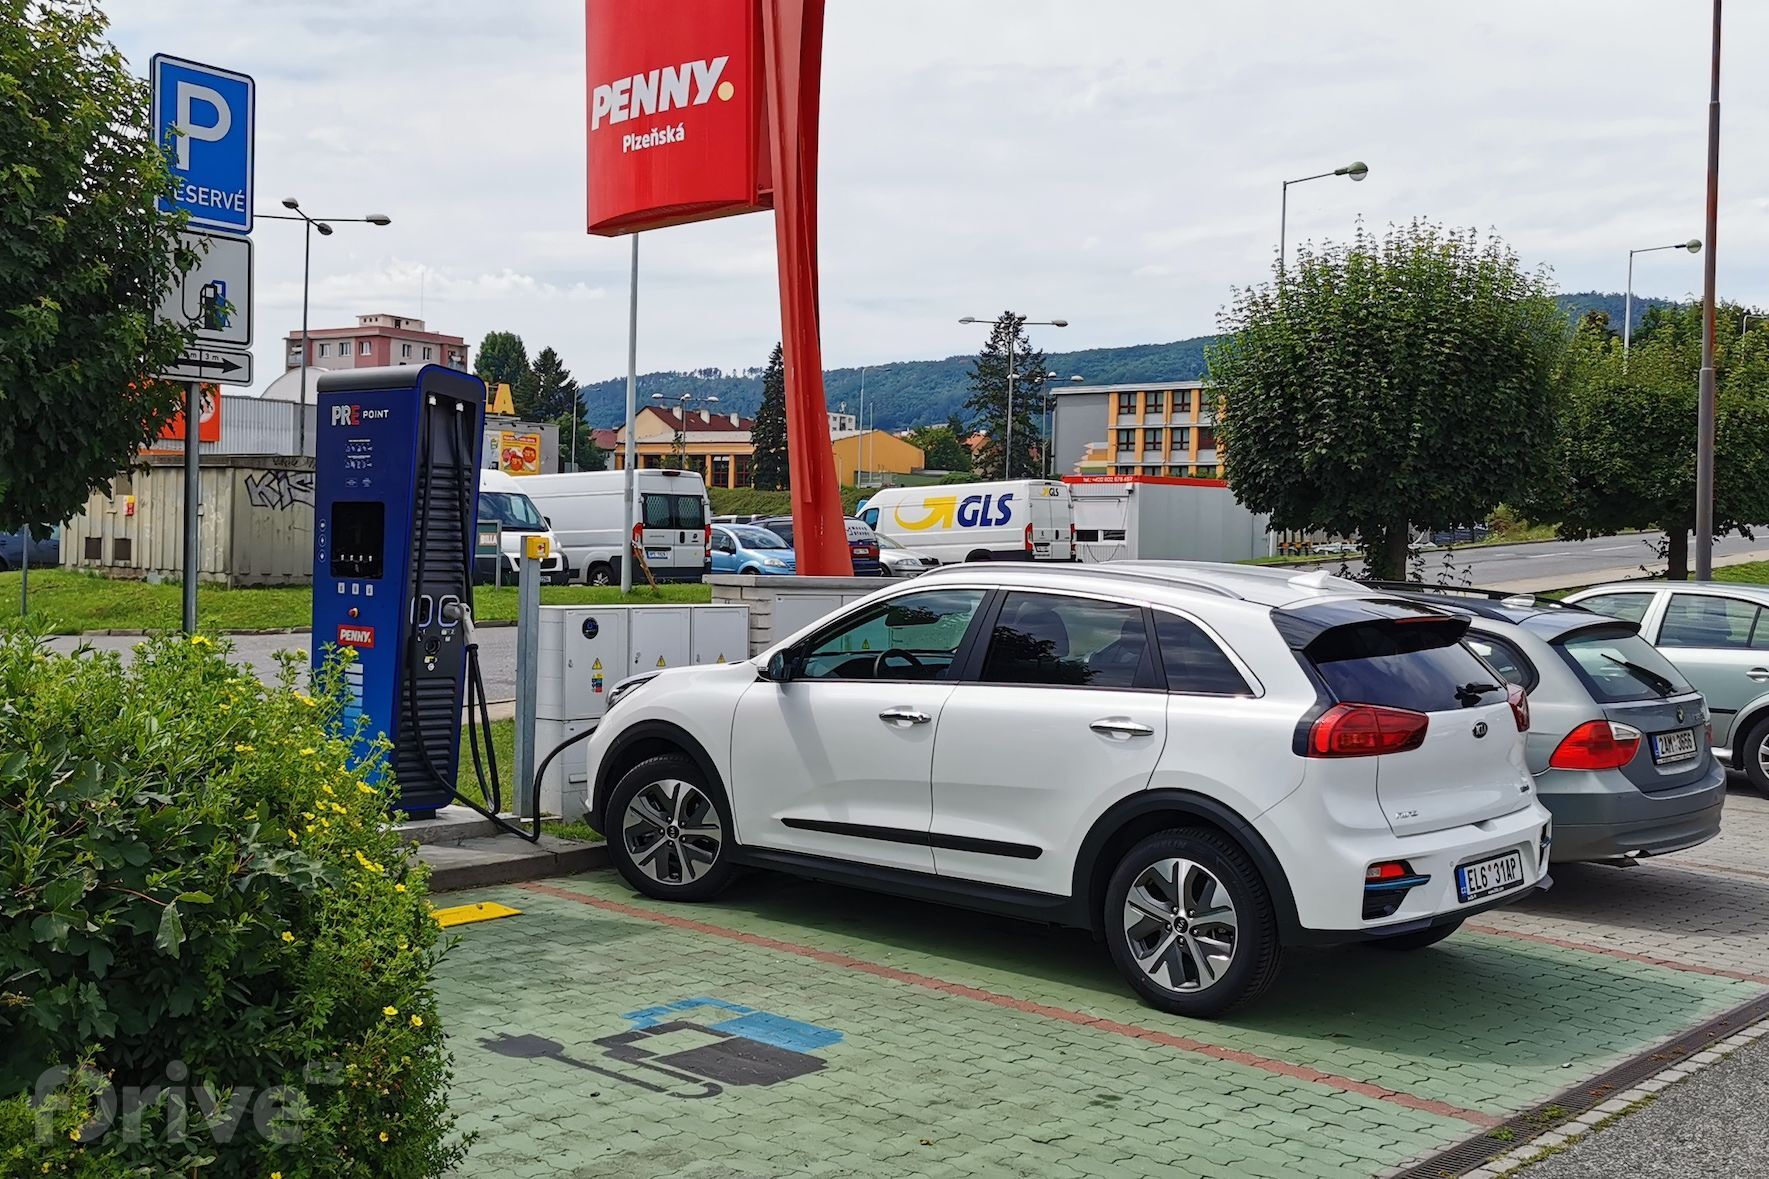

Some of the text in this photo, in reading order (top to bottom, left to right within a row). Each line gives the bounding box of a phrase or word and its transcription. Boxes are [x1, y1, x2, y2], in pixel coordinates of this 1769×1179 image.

[176, 80, 232, 171] P
[622, 122, 685, 153] Plzeňská
[160, 182, 245, 213] ESERVÉ
[331, 405, 390, 426] PRE POINT
[1048, 487, 1060, 497] GLS
[957, 493, 1014, 528] GLS
[1467, 858, 1516, 892] EL6 31AP
